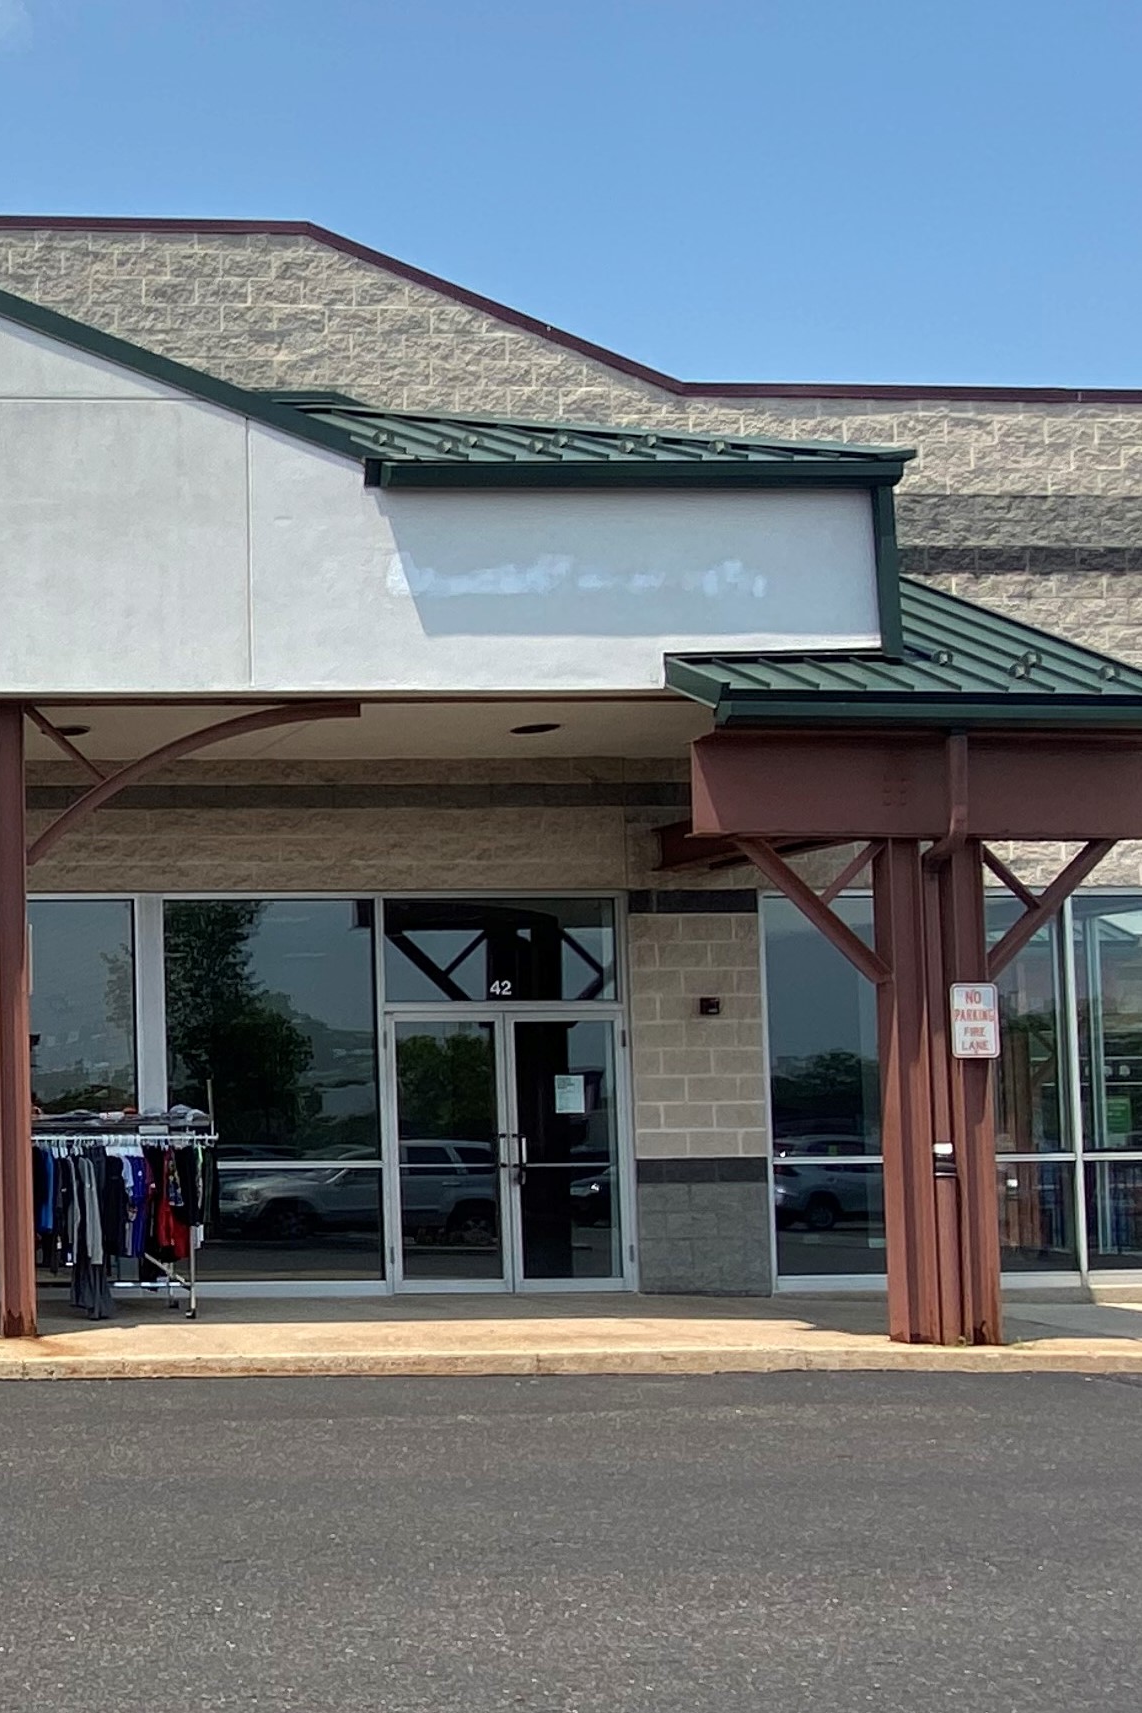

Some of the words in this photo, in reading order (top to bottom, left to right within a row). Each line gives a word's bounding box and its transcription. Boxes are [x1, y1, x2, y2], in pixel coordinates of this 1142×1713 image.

[489, 980, 512, 995] 42
[965, 990, 982, 1004] NO
[954, 1008, 995, 1022] PARKING
[963, 1026, 986, 1037] FIRE
[962, 1040, 990, 1051] LANE
